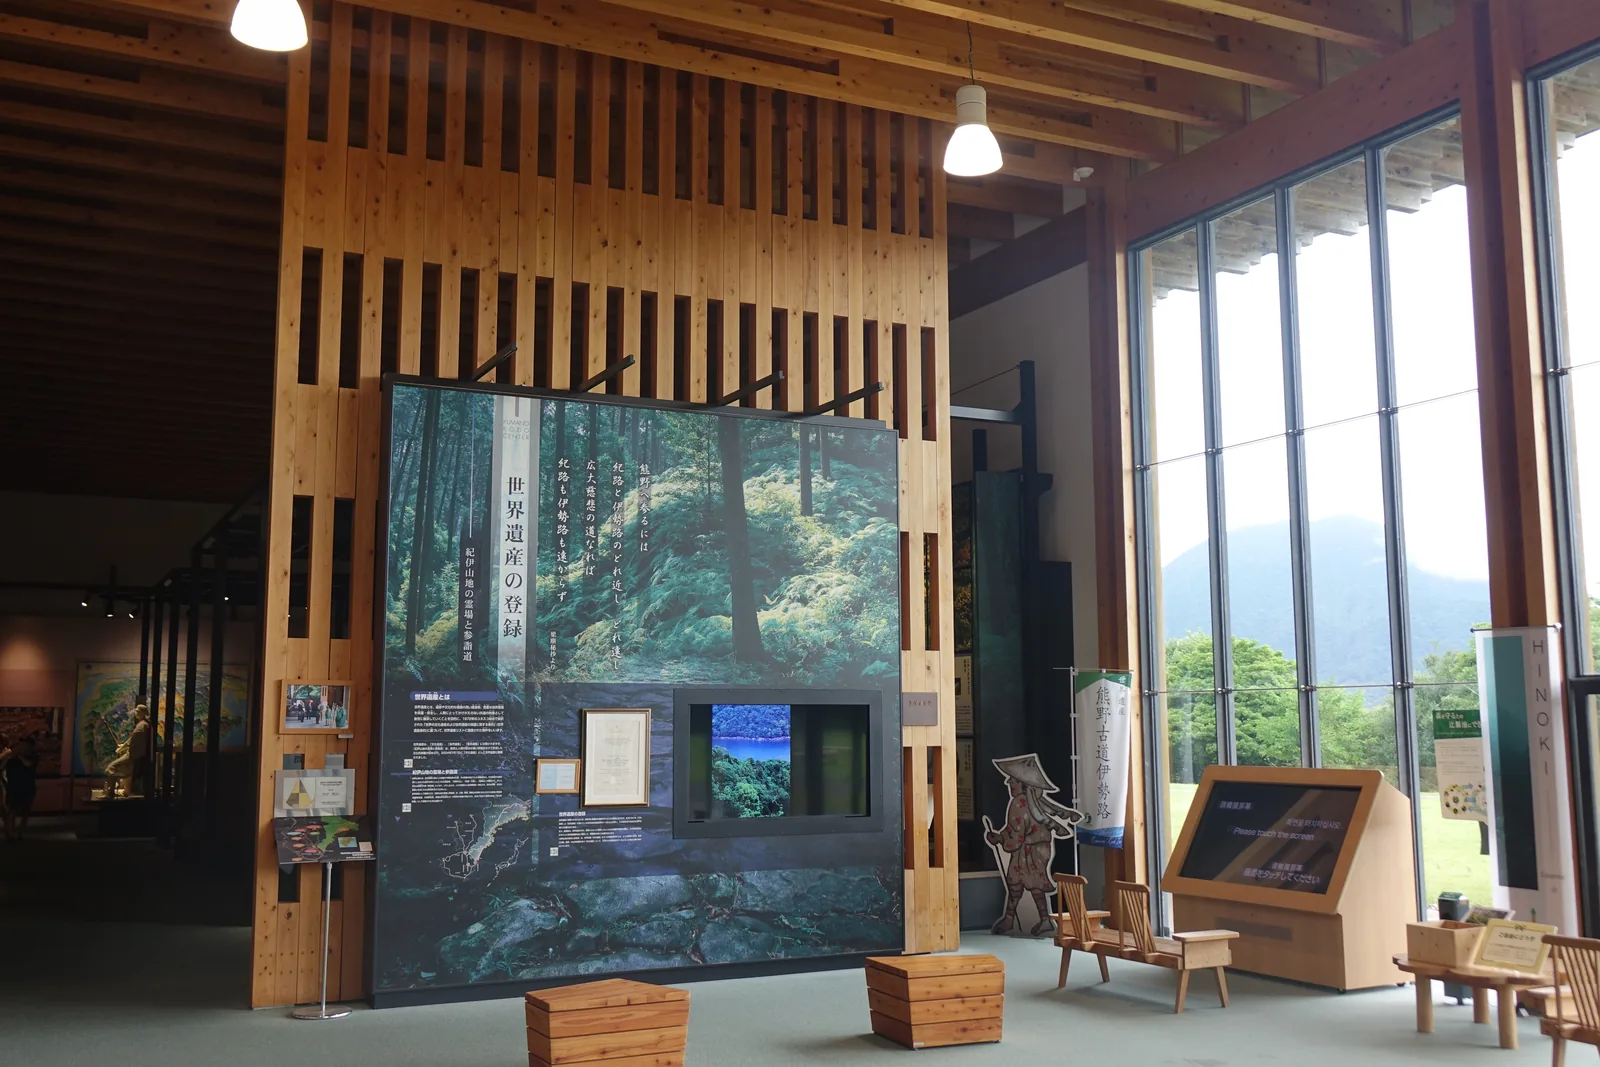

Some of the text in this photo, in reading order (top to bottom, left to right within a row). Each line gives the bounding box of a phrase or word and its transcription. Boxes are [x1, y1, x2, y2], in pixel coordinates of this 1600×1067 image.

[503, 476, 525, 638] 世界遺産の登録
[556, 457, 570, 603] 紀路も伊勢路も遠からず
[585, 459, 597, 577] 広大慈悲の道なれば
[610, 462, 624, 670] 紀路と伊勢路のどれ近し どれ遠し
[639, 463, 651, 553] 熊野へ参るには
[462, 547, 476, 662] 紀伊山地の霊場と参詣道
[1095, 685, 1112, 820] 熊野古道伊勢路
[1532, 640, 1550, 776] HINOKI
[1233, 826, 1256, 836] Please
[1257, 828, 1277, 837] touch
[1278, 831, 1289, 839] the
